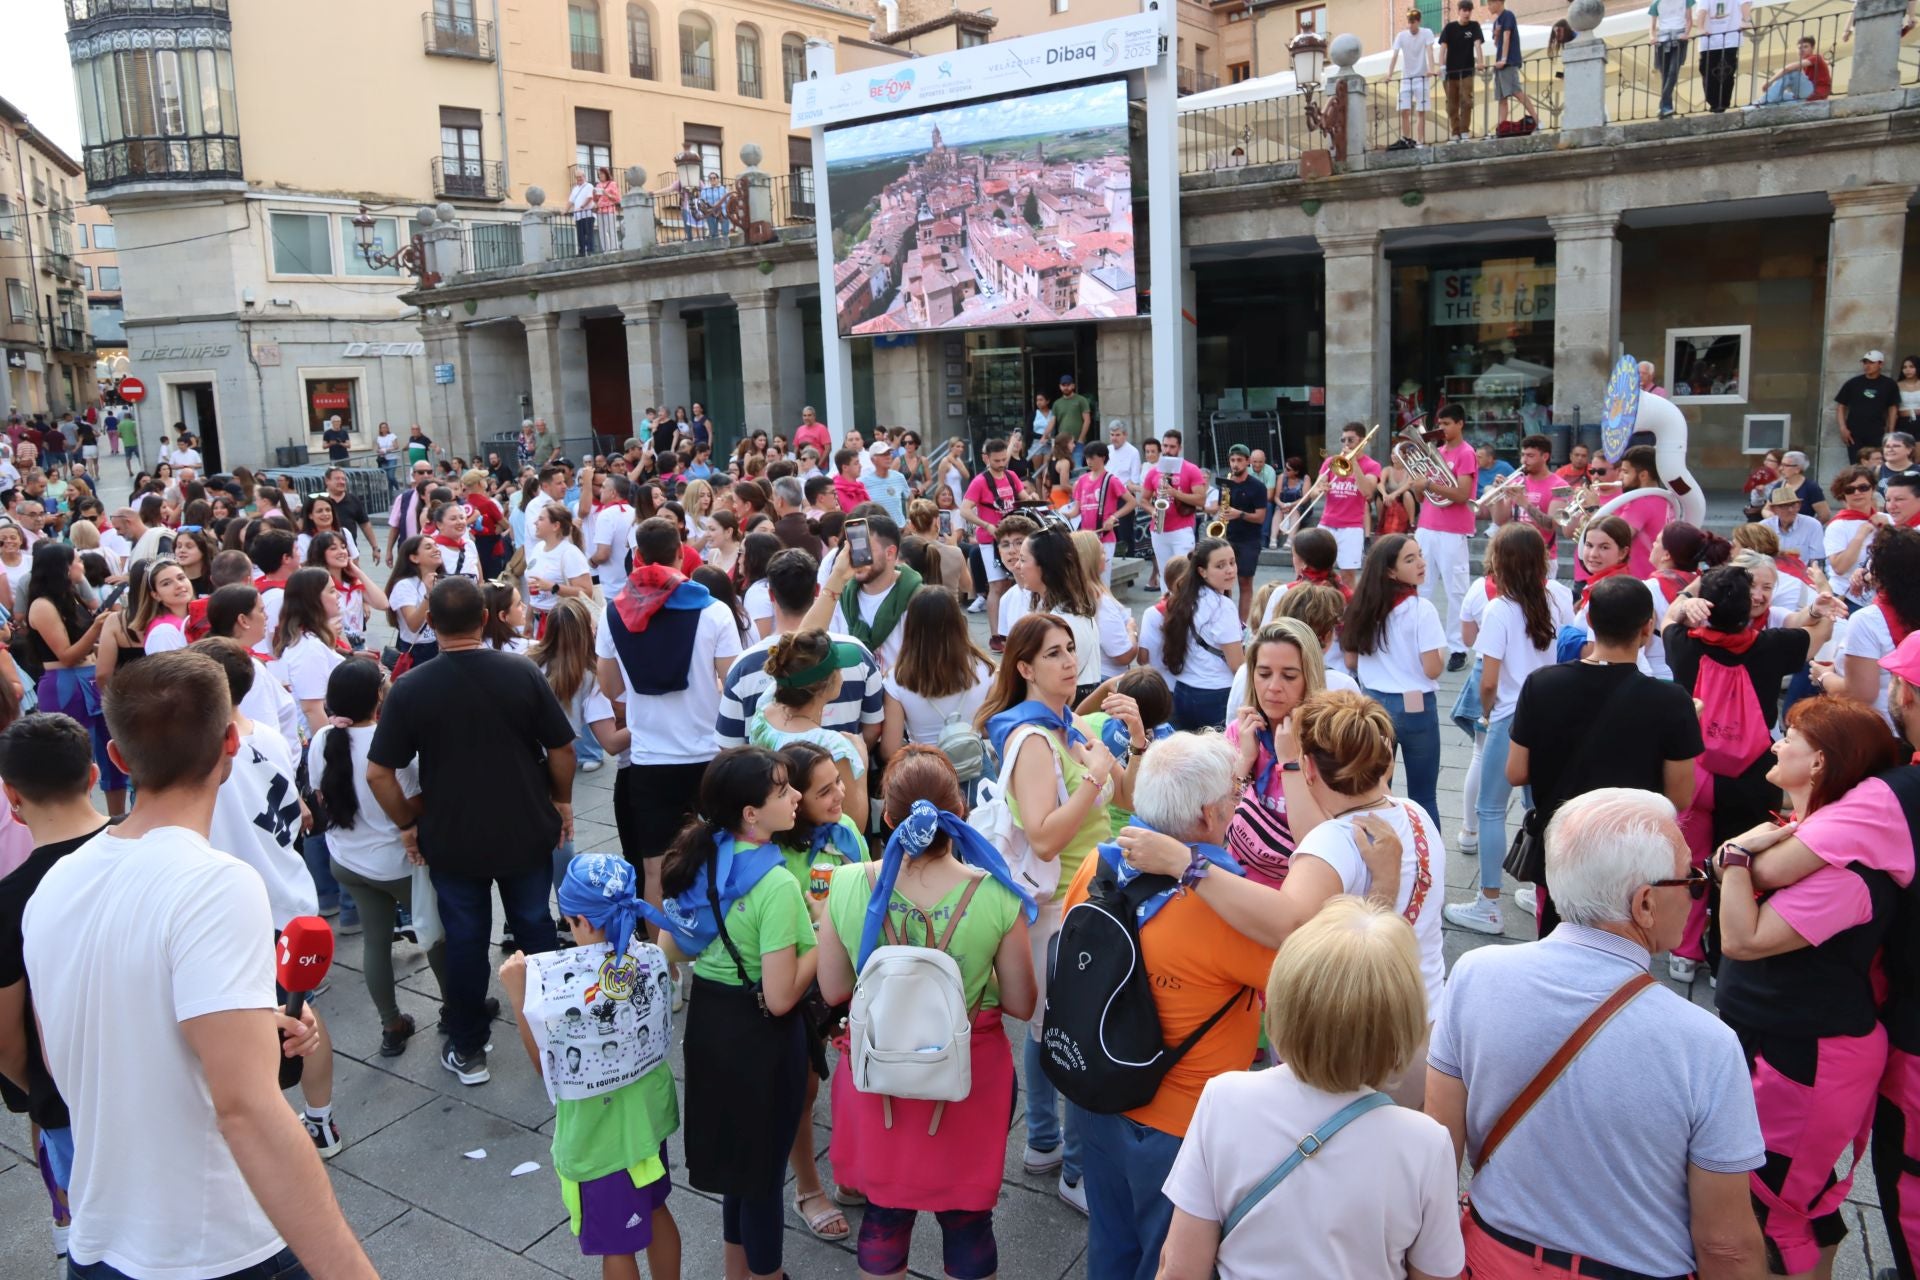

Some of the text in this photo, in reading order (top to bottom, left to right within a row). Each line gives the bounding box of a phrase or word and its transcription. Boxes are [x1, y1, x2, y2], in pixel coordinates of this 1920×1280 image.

[1046, 45, 1097, 65] Dibaq
[1124, 47, 1151, 60] 2025
[1445, 297, 1549, 319] THE SHOP
[1235, 824, 1255, 848] since
[587, 1082, 595, 1090] EL
[596, 1077, 620, 1088] EQUIPO
[621, 1072, 630, 1081] DE
